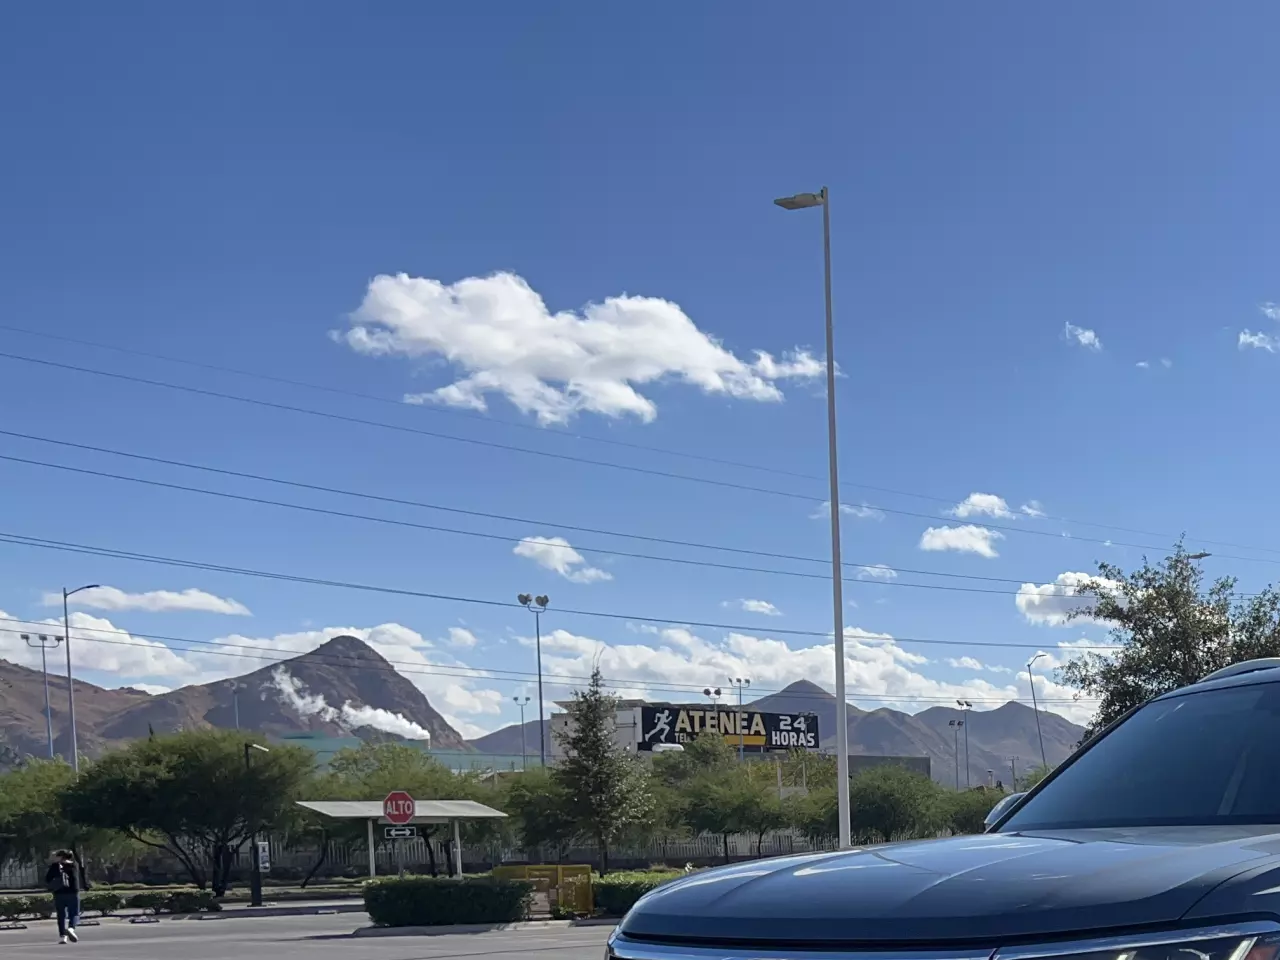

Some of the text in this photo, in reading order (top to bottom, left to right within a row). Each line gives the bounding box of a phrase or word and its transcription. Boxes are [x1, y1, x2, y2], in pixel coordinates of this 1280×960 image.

[674, 710, 767, 735] ATENEA
[779, 715, 806, 730] 24
[771, 731, 815, 747] HORAS
[386, 800, 413, 815] ALTO
